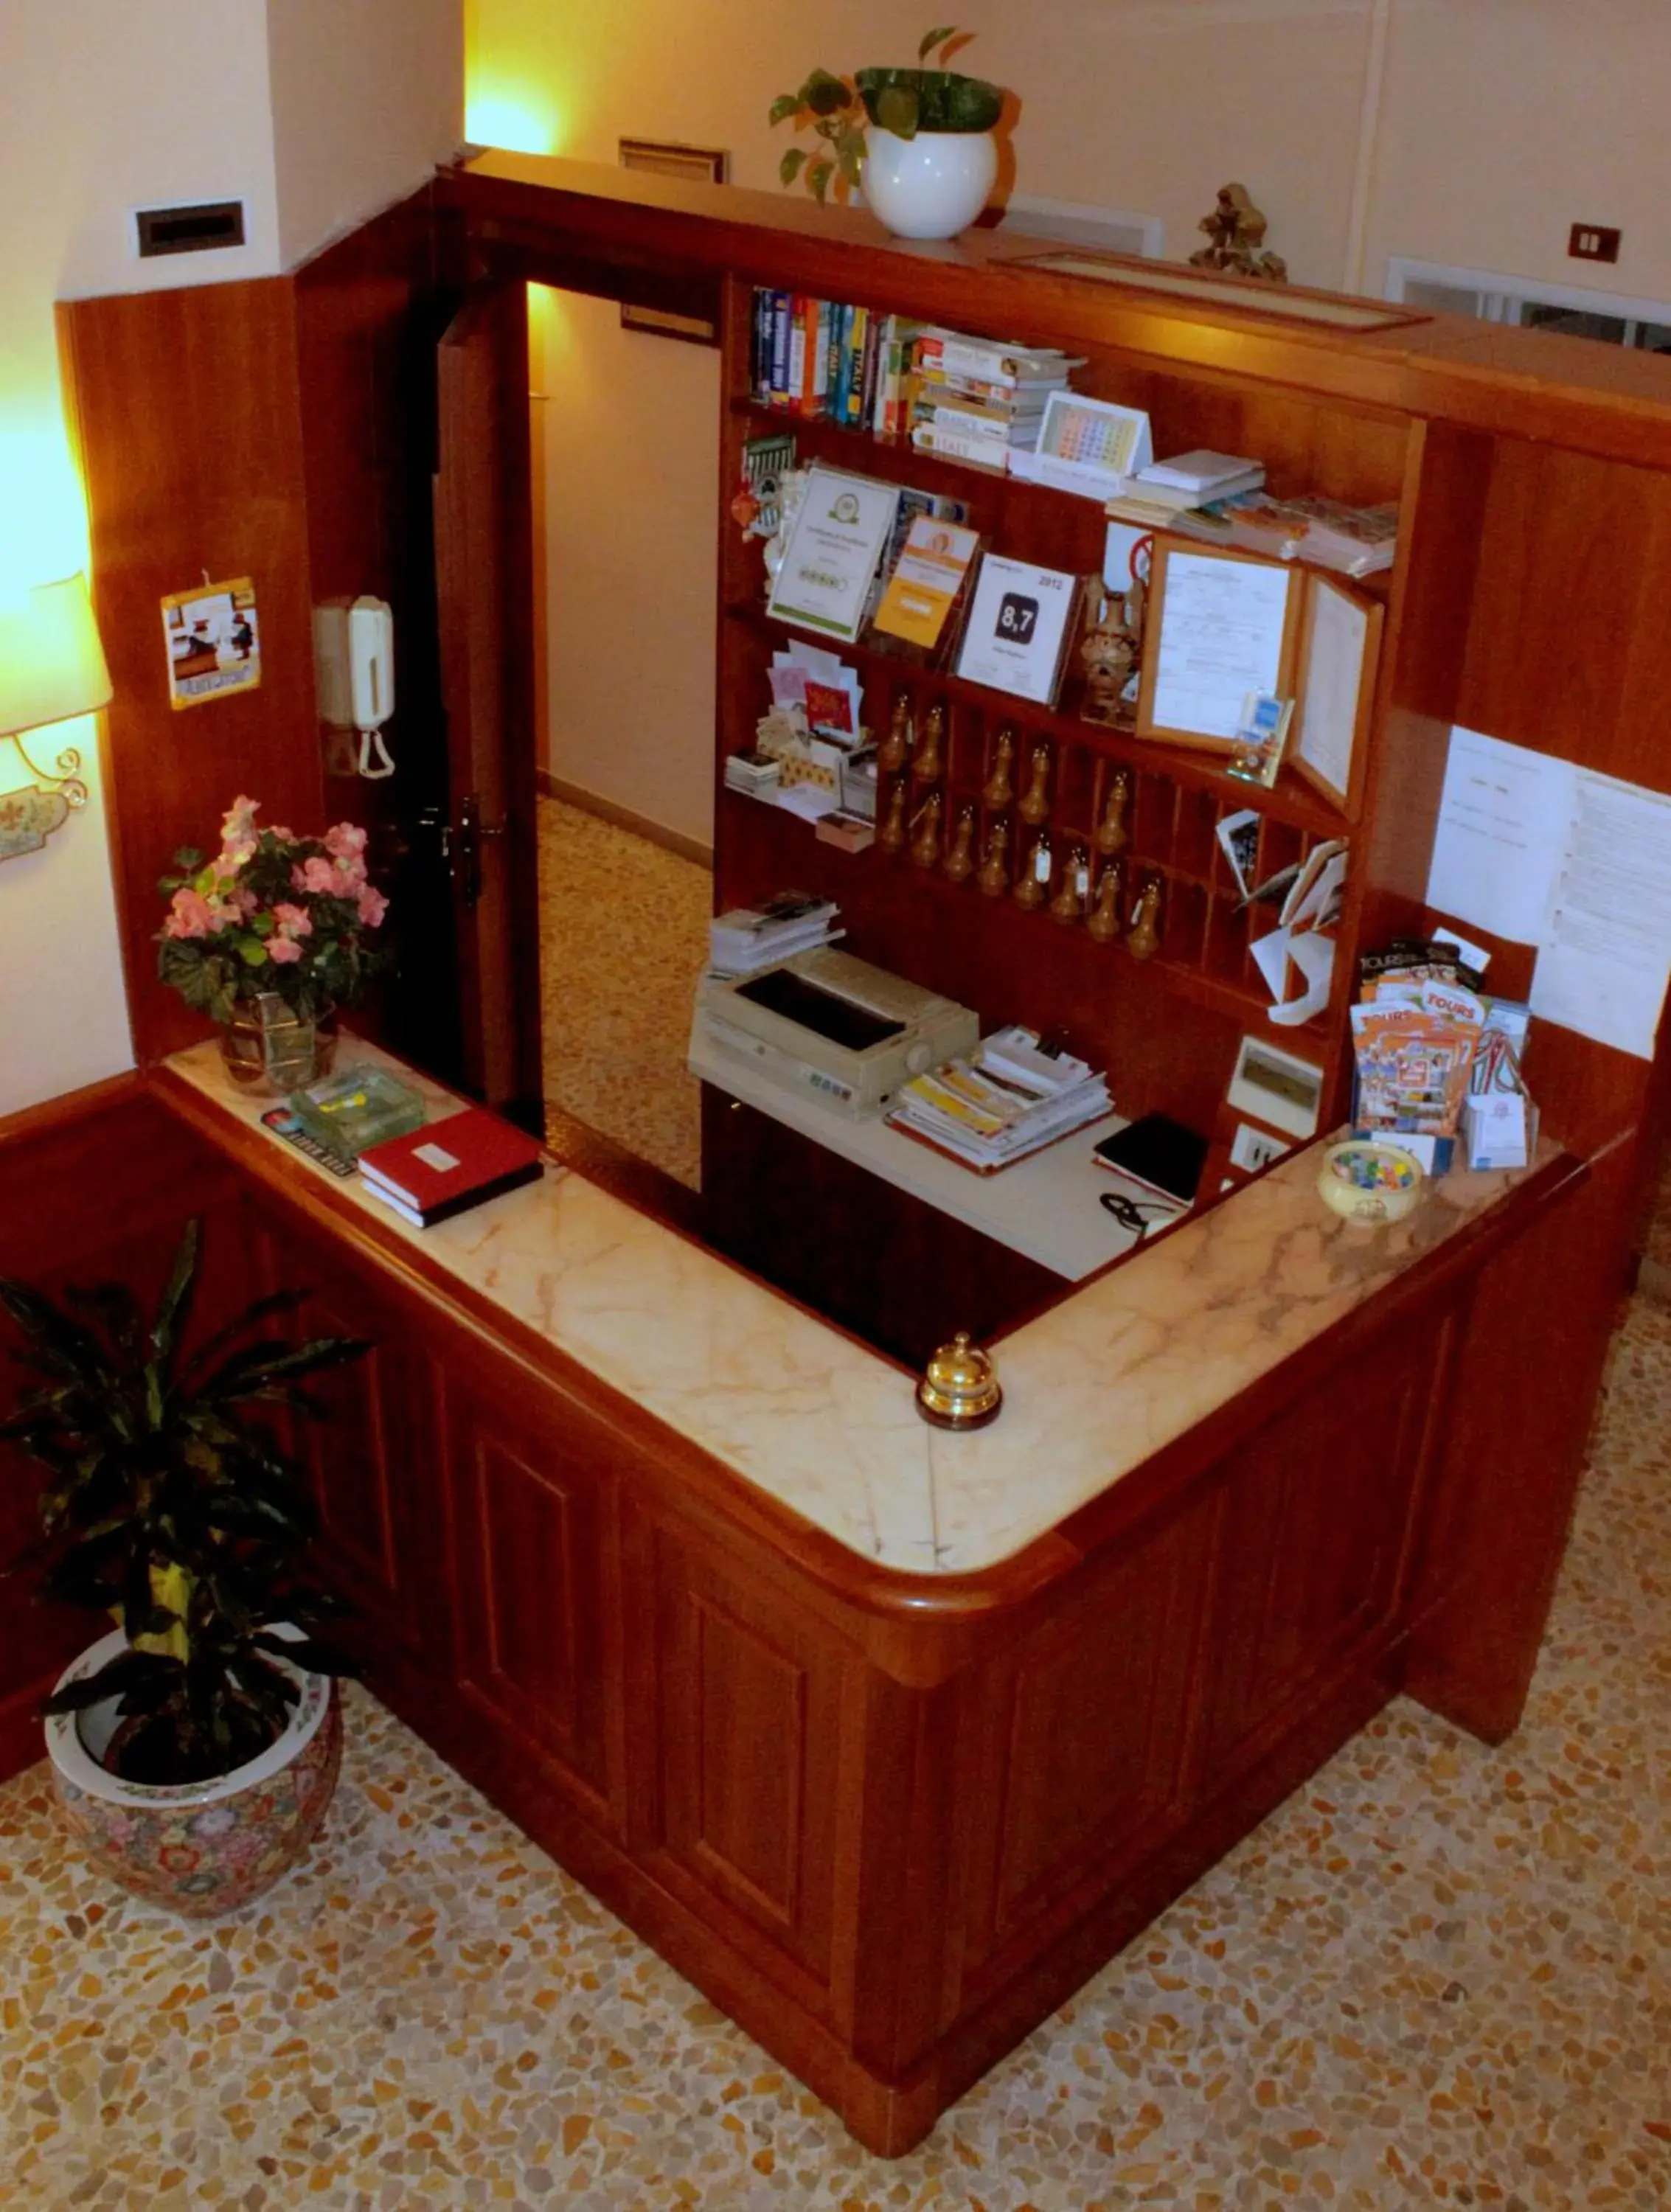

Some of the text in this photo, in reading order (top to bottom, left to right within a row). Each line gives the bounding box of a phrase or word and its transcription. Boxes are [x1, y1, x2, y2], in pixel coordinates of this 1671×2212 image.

[853, 353, 863, 391] ITALY
[1039, 576, 1063, 591] 2012
[1001, 605, 1033, 633] 8,7
[1428, 992, 1475, 1019] TOURS
